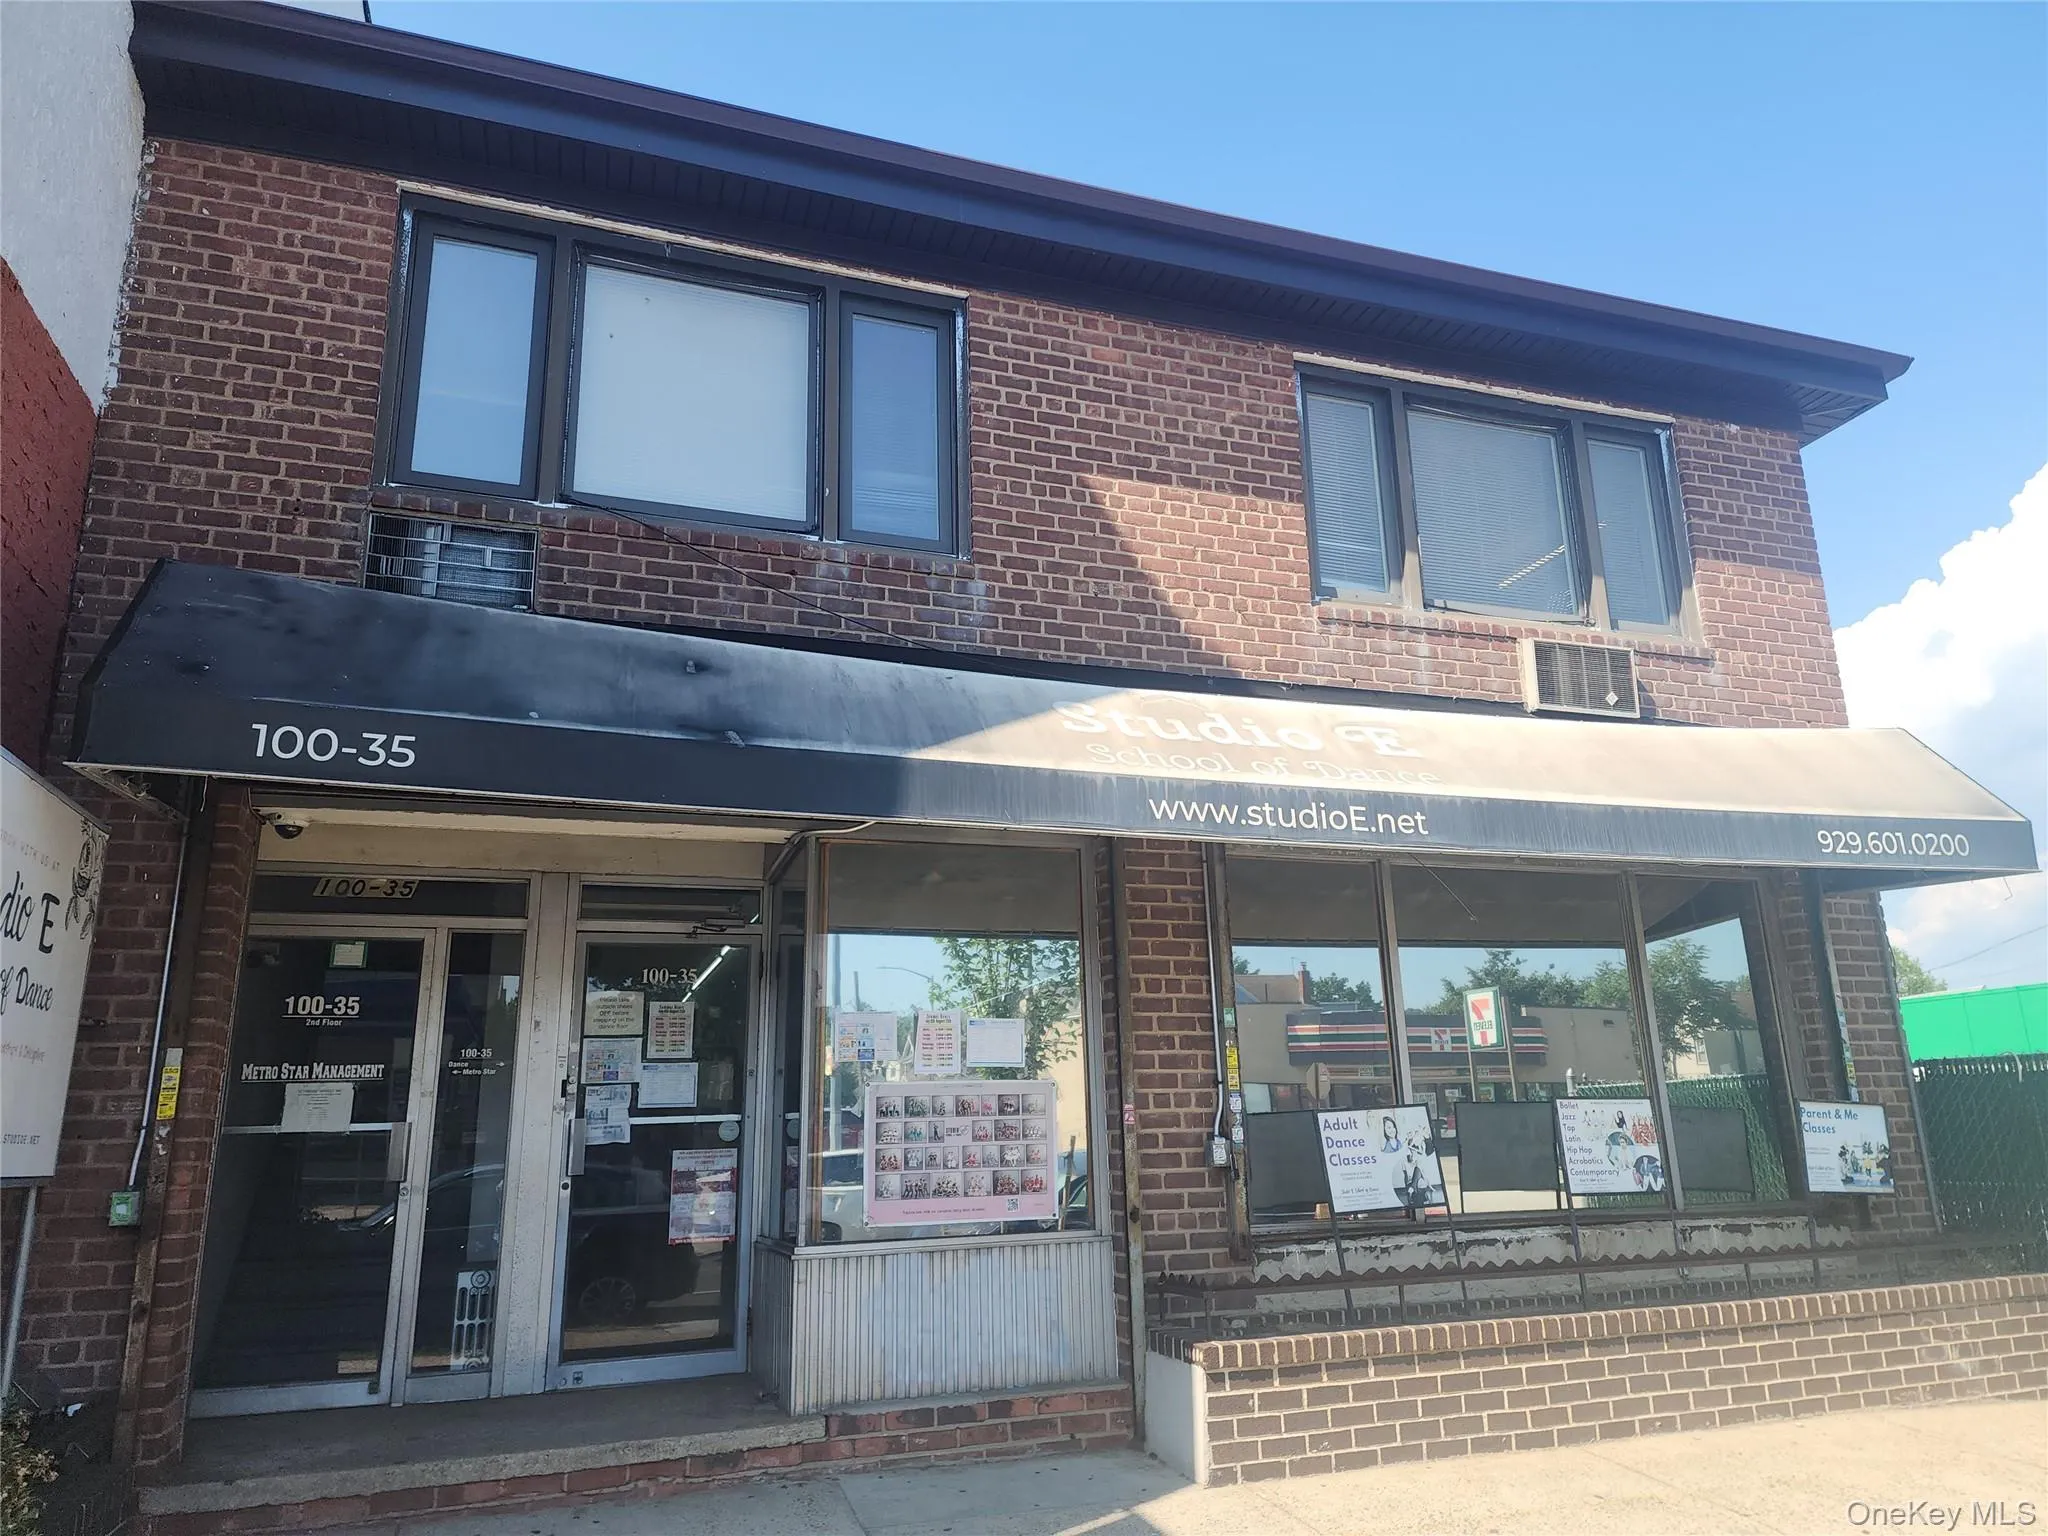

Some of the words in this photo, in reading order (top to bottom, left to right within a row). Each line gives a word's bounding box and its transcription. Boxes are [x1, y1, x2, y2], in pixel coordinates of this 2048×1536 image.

[1052, 701, 1324, 750] Studio
[1335, 723, 1423, 758] E
[251, 723, 417, 768] 100-35
[1086, 743, 1238, 774] School
[1250, 756, 1292, 776] of
[1303, 760, 1443, 787] Dance
[1148, 798, 1430, 836] www.studioE.net
[1816, 829, 1971, 857] 929.601.0200
[318, 878, 416, 898] 100-35
[38, 892, 61, 954] E
[641, 967, 698, 984] 100-35
[15, 966, 54, 1013] Dance
[284, 995, 361, 1016] 100-35
[305, 1018, 320, 1027] 2nd
[322, 1018, 343, 1027] Floor
[460, 1048, 493, 1058] 100-35
[1800, 1107, 1832, 1119] Parent
[1834, 1108, 1842, 1120] &
[1844, 1109, 1858, 1120] Me
[1323, 1117, 1358, 1131] Adult
[1563, 1123, 1576, 1132] Tap
[1802, 1122, 1836, 1134] Classes
[1325, 1136, 1365, 1149] Dance
[1566, 1146, 1578, 1155] Hip
[1579, 1145, 1592, 1155] Hop
[1329, 1153, 1377, 1167] Classes
[1568, 1157, 1603, 1165] Acrobatics
[1570, 1167, 1620, 1176] Contemporary
